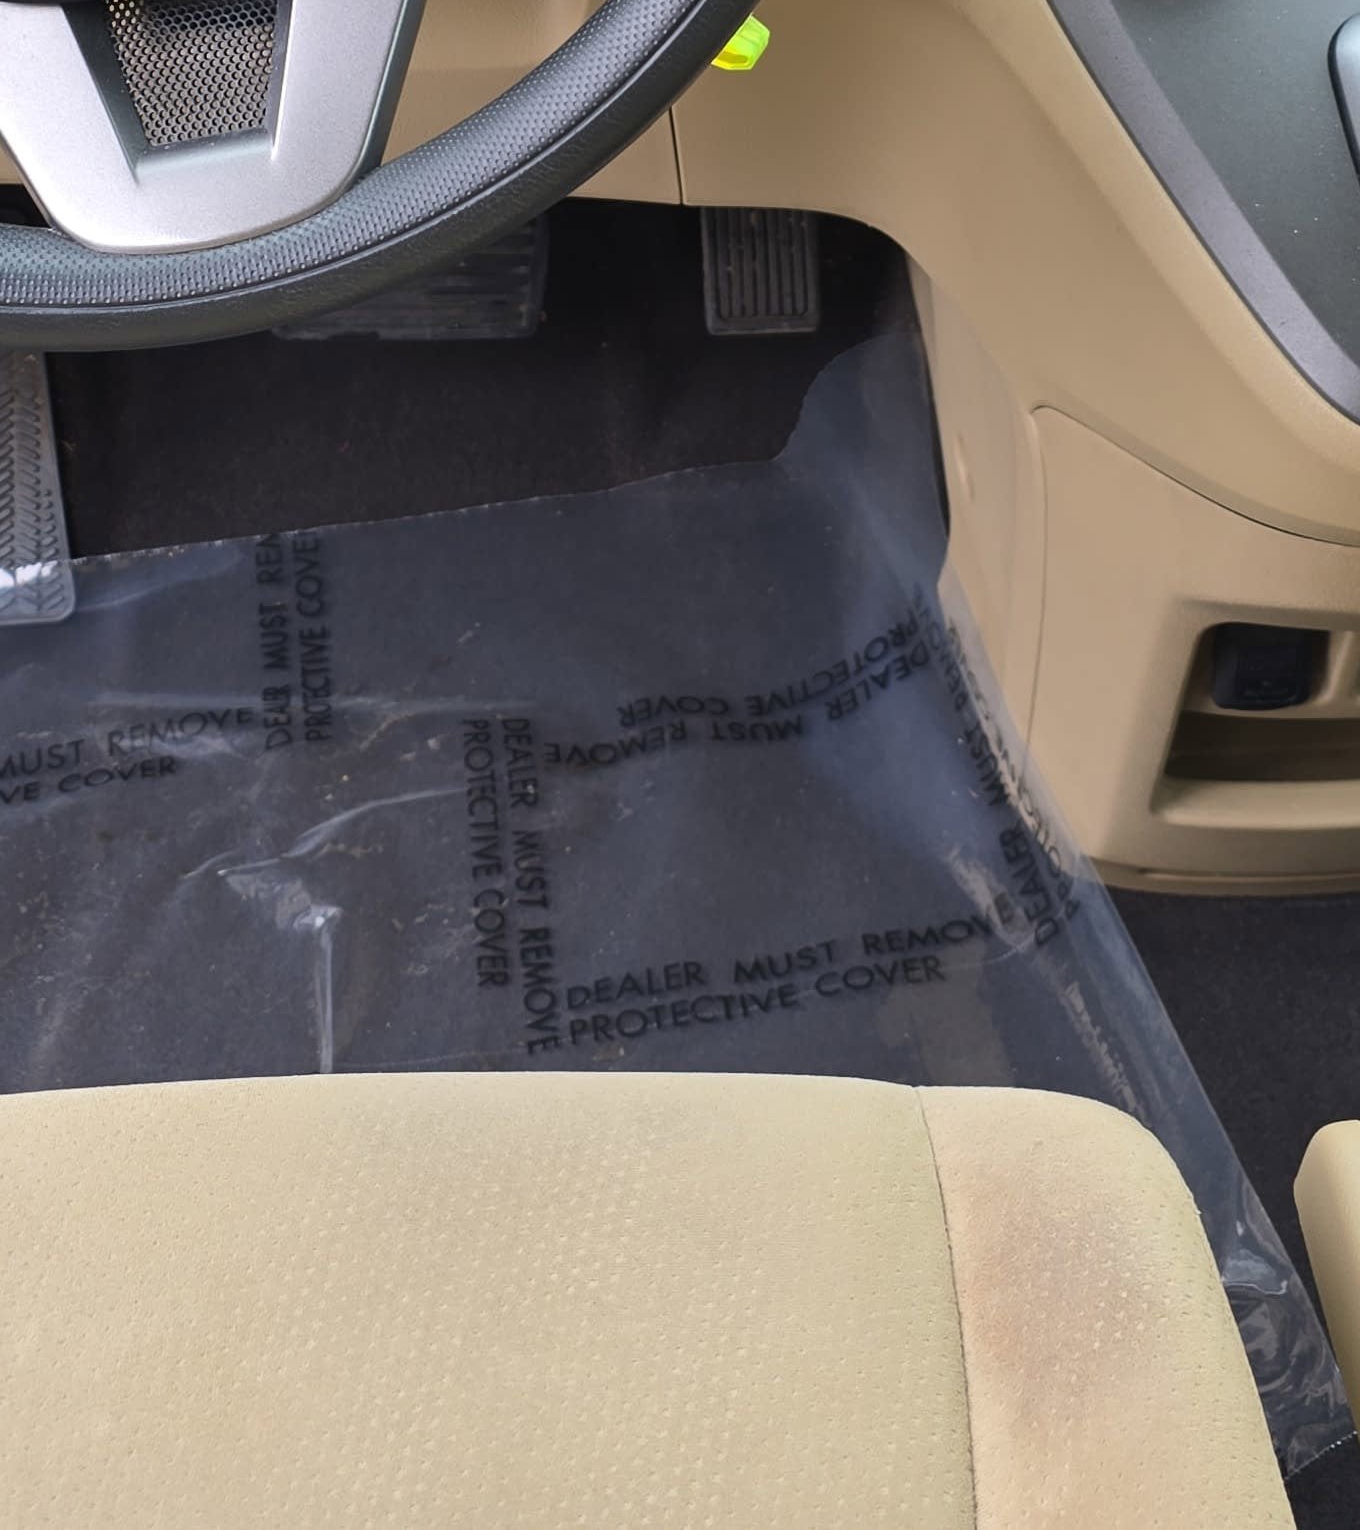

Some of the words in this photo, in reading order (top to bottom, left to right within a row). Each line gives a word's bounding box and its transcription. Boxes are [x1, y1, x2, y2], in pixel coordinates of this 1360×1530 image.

[291, 532, 323, 618] COVE
[259, 602, 290, 670] MUST
[618, 695, 730, 729] COVER
[826, 640, 930, 722] DEALER
[107, 707, 255, 757] REMOVE
[501, 718, 539, 810] DEALER
[544, 720, 687, 766] REMOVE
[710, 715, 803, 745] MUST
[58, 756, 177, 793] COVER
[462, 718, 503, 879] PROTECTIVE
[512, 830, 550, 910] MUST
[473, 888, 511, 987] COVER
[567, 959, 707, 1010] DEALER
[734, 938, 839, 985] MUST
[862, 891, 1017, 957] REMOVE
[520, 927, 564, 1054] REMOVE
[569, 983, 800, 1047] PROTECTIVE
[814, 954, 947, 999] COVER
